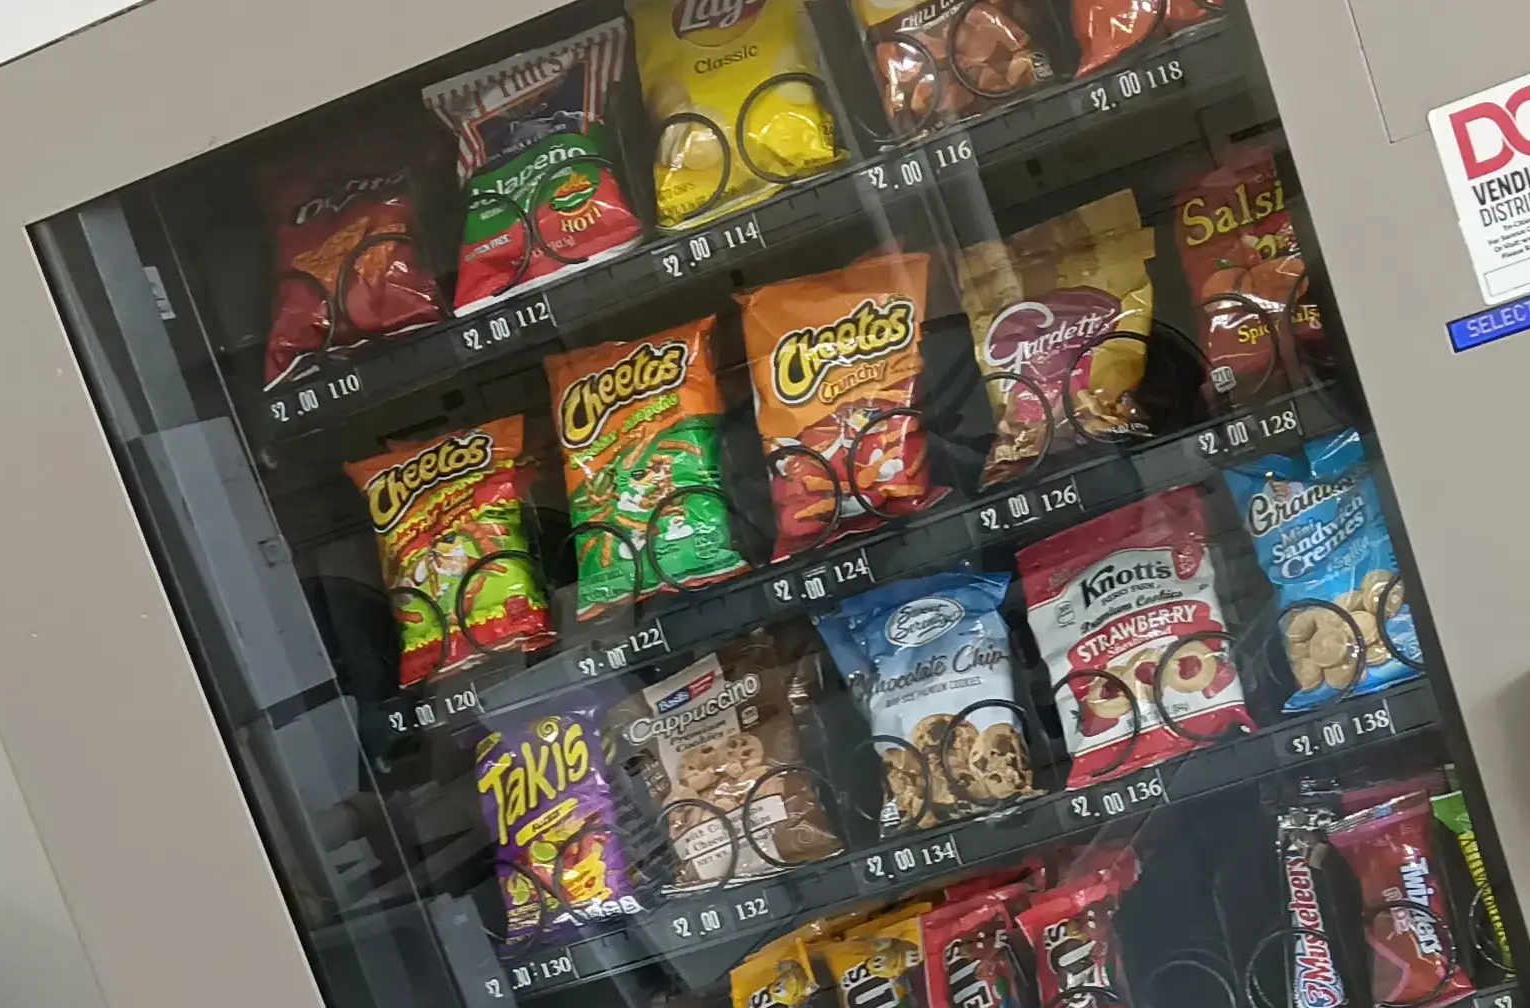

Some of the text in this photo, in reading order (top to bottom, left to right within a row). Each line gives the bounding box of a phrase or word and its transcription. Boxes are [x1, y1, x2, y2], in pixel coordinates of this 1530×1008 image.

[693, 45, 759, 75] Classic
[1146, 61, 1184, 89] 118
[936, 140, 971, 168] 116
[561, 205, 603, 233] HOT!
[1181, 179, 1286, 247] Salsi
[724, 221, 759, 248] 114
[516, 302, 549, 329] 112
[771, 299, 914, 405] Cheetos
[327, 374, 361, 400] 110
[561, 341, 688, 448] Cheetos
[818, 360, 890, 404] Crunchy
[1259, 411, 1297, 438] 128
[370, 433, 493, 533] Cheetos
[1041, 486, 1077, 512] 126
[1272, 495, 1366, 564] Sandwich
[1281, 511, 1366, 579] Cremes
[834, 558, 867, 584] 124
[1080, 559, 1172, 608] Knott's
[629, 628, 662, 652] 122
[1077, 602, 1198, 664] STRAWBERRY
[952, 644, 1010, 674] Chip
[444, 691, 476, 715] 120
[629, 673, 761, 746] Cappuccino
[1353, 710, 1390, 735] 138
[477, 723, 589, 847] Takis
[1127, 778, 1162, 803] 136
[921, 842, 955, 865] 134
[736, 899, 769, 921] 132
[540, 956, 571, 980] 130
